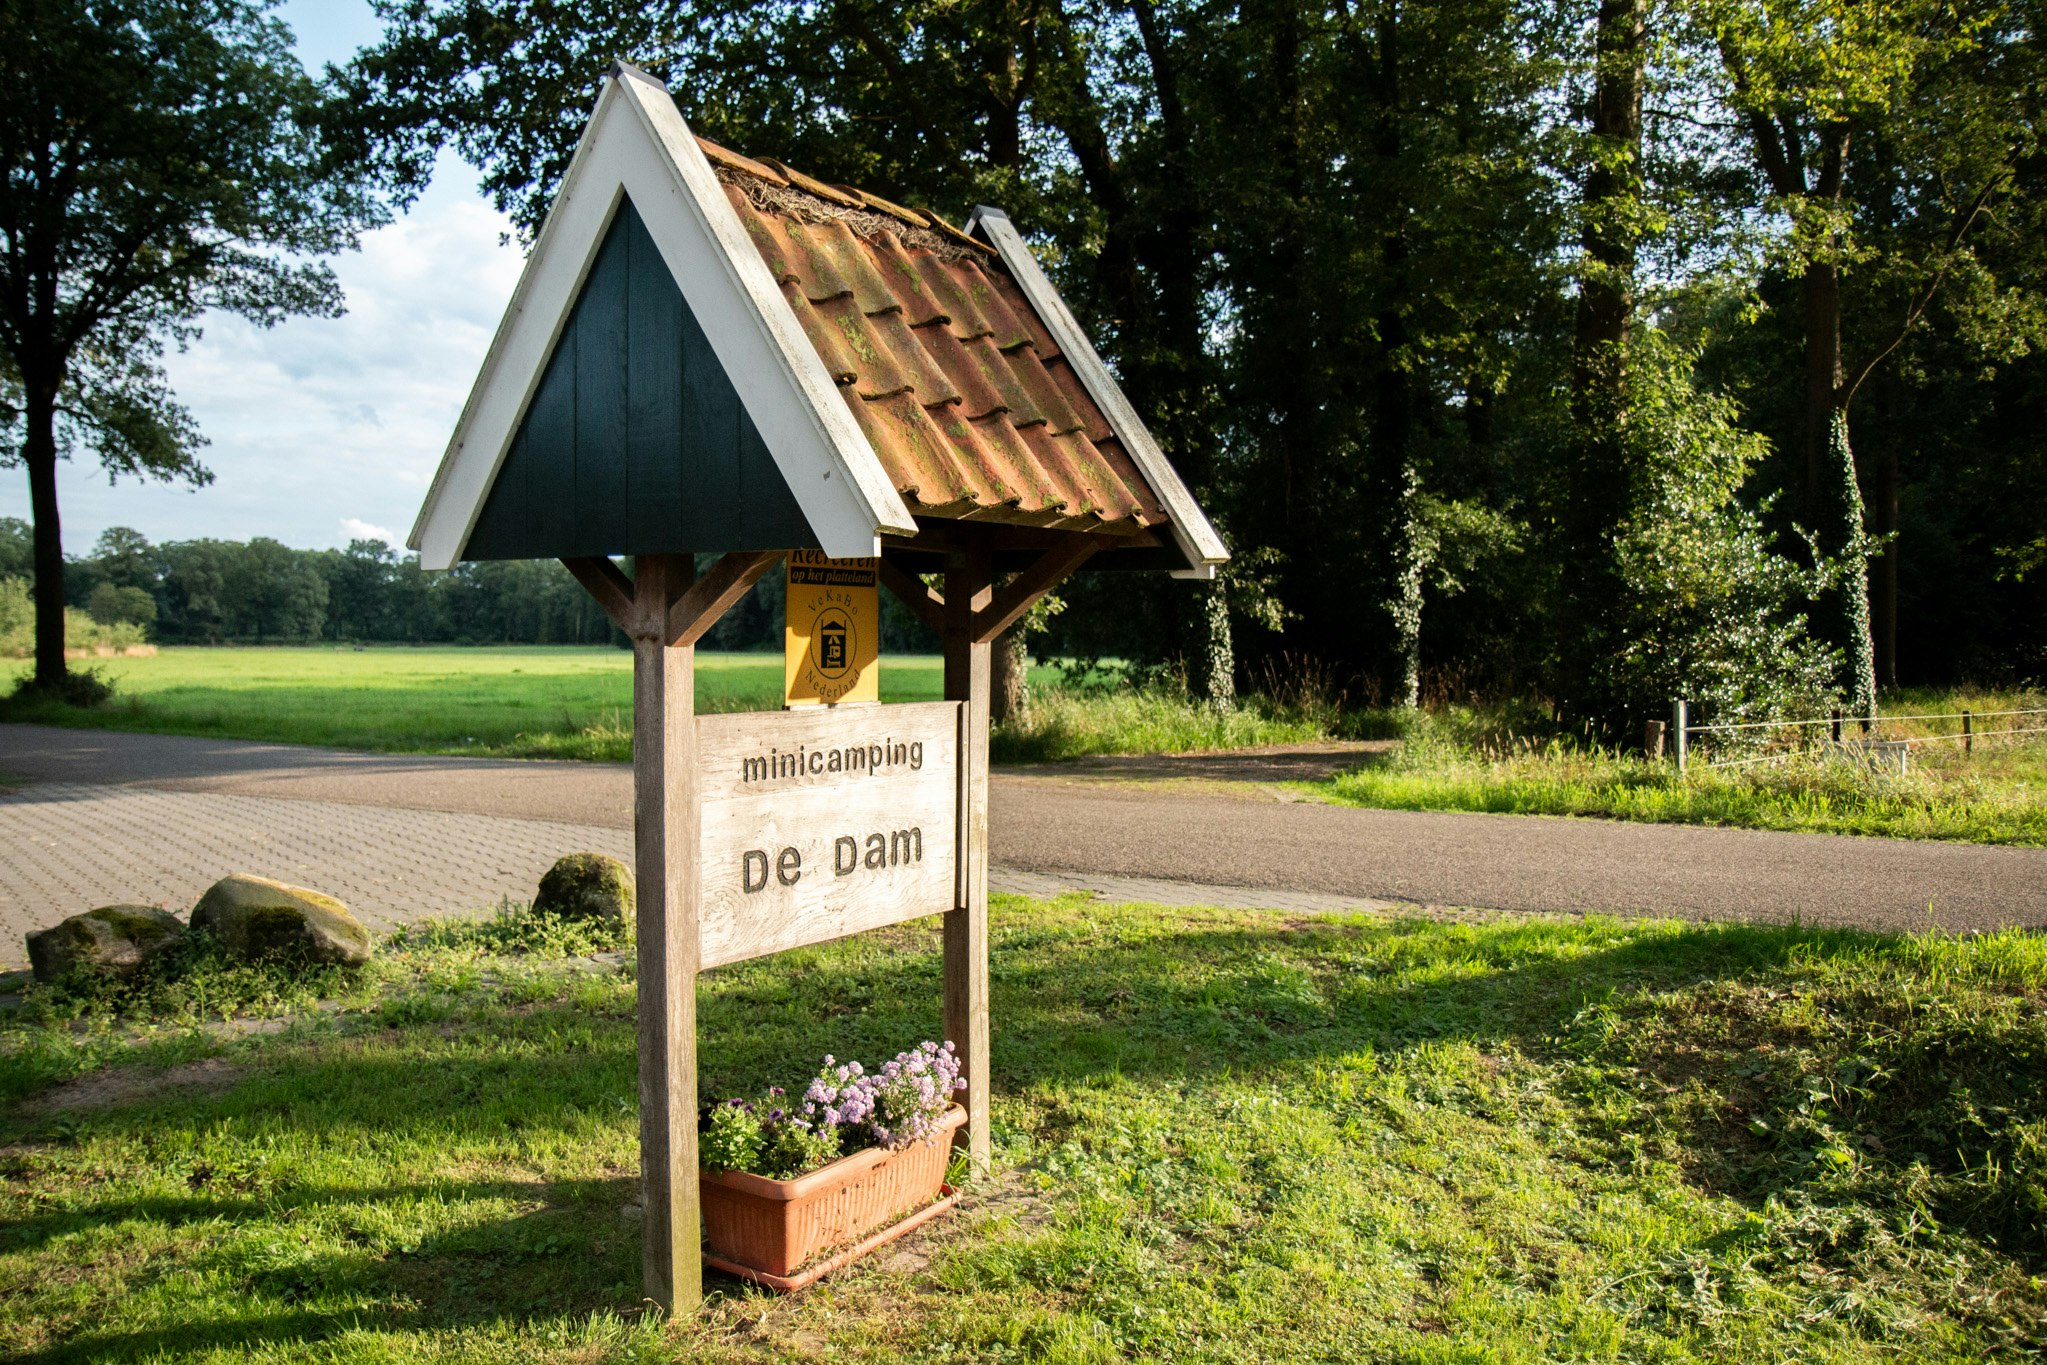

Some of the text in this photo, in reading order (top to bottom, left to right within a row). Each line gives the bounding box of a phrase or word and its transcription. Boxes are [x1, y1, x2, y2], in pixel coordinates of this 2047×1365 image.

[792, 568, 874, 585] op het platteland
[808, 589, 858, 616] VeKaBo
[805, 668, 861, 698] Nederland
[742, 737, 923, 783] minicamping
[742, 826, 922, 894] De Dam
